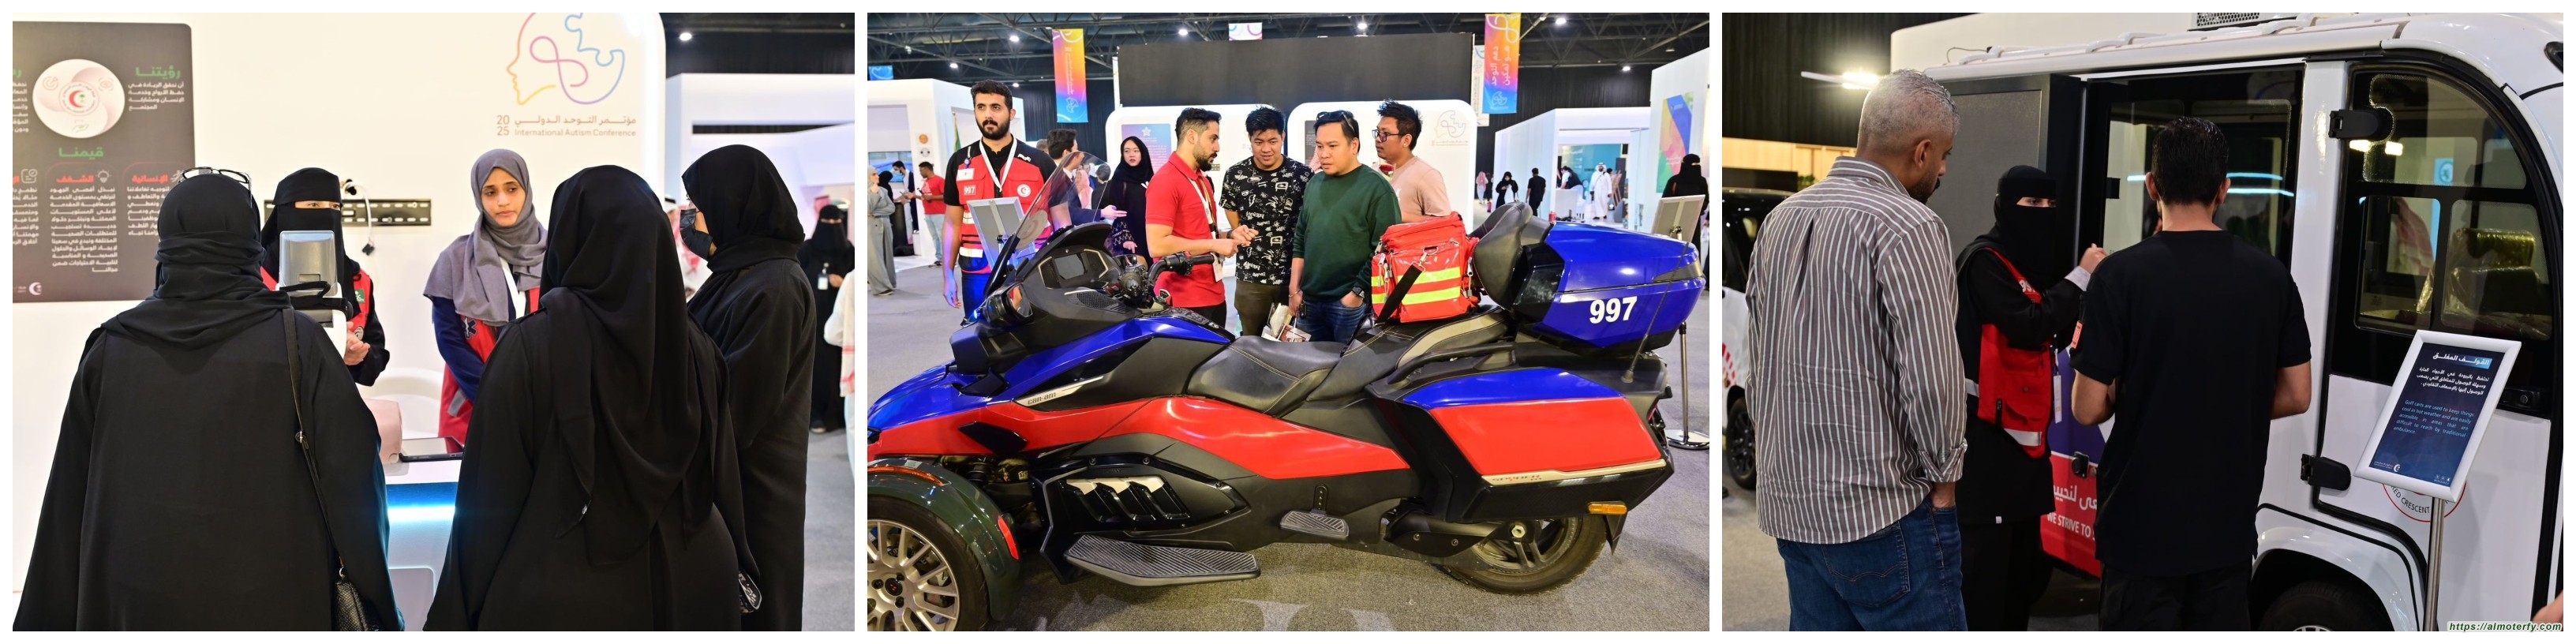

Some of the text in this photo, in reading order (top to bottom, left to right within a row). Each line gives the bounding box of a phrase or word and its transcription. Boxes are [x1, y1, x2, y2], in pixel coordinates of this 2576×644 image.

[496, 115, 510, 125] 20
[515, 115, 637, 127] مؤتمر التوحد الدولي
[496, 126, 510, 137] 25
[58, 147, 104, 160] قيمنا
[964, 186, 976, 195] 997
[1589, 296, 1637, 324] 997
[1028, 392, 1056, 405] can-am
[2442, 429, 2466, 437] traditional
[2401, 497, 2430, 513] CRESCENT
[2047, 512, 2057, 524] WE
[2058, 515, 2080, 534] STRIVE
[2081, 523, 2091, 537] TO
